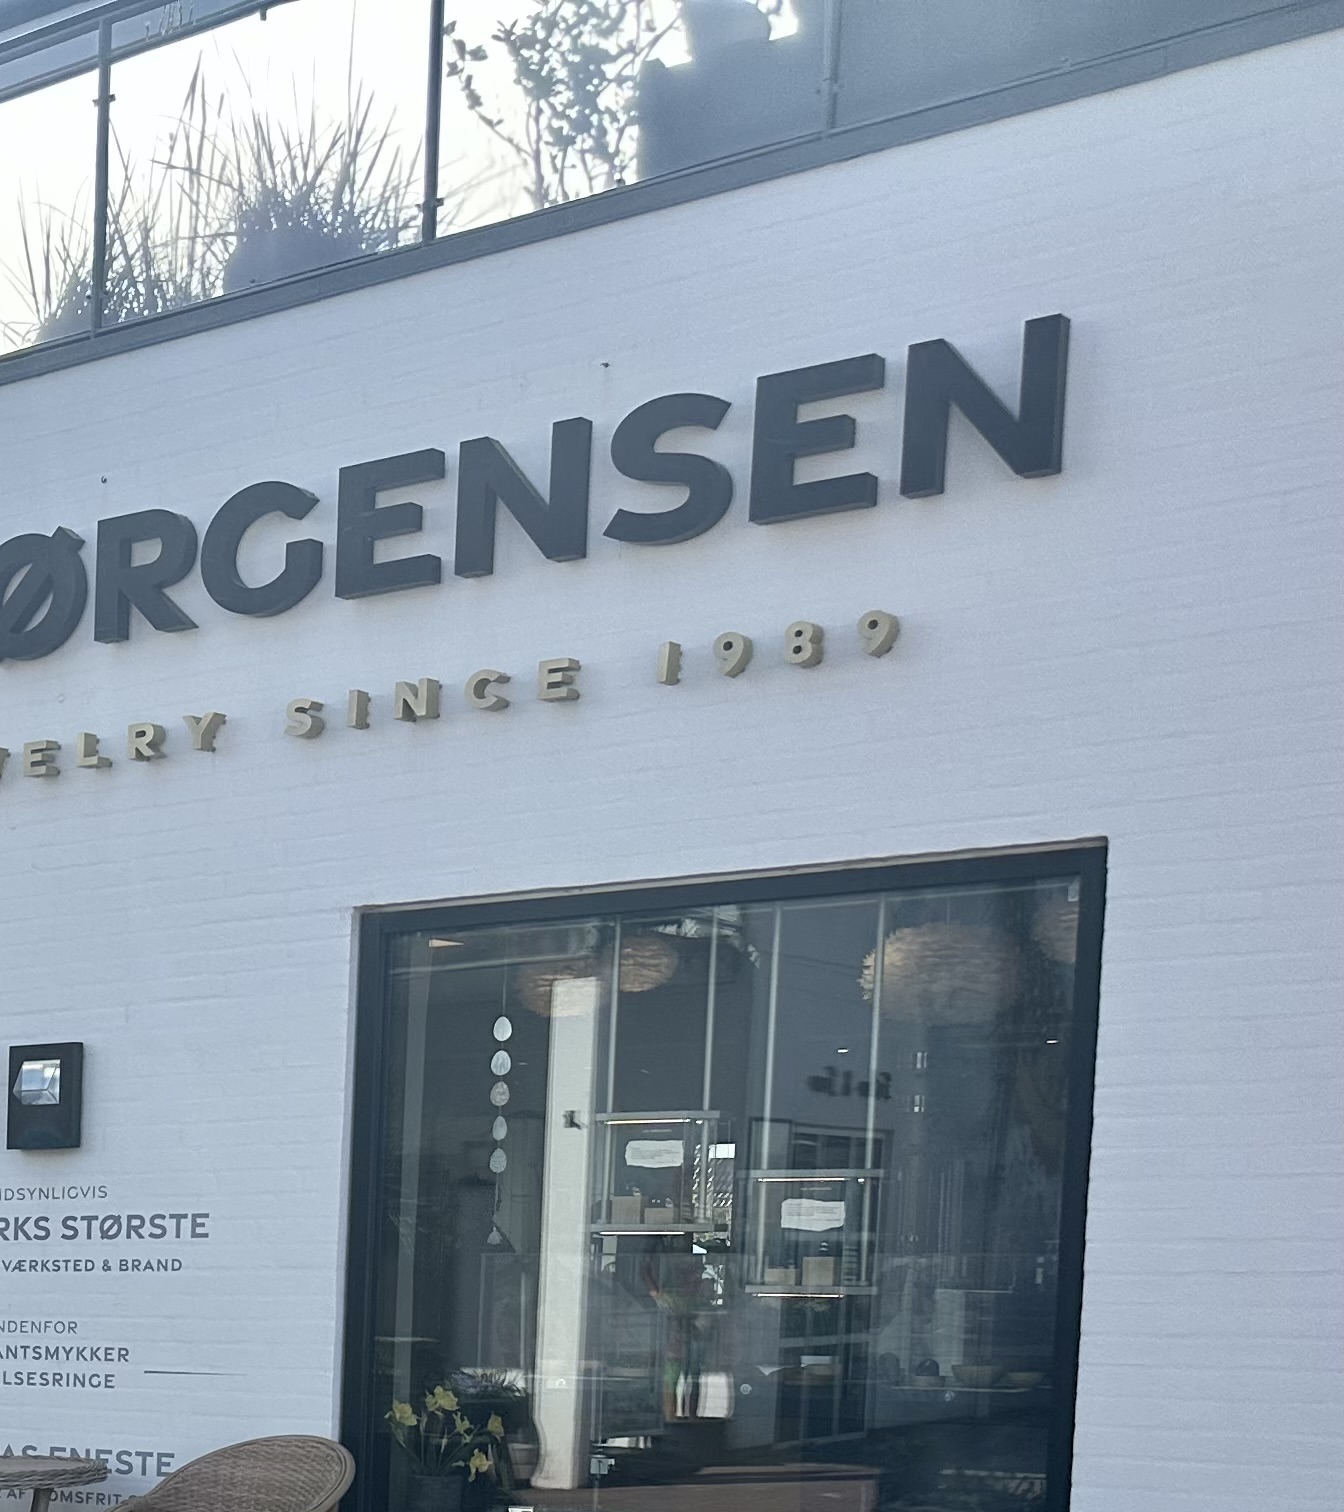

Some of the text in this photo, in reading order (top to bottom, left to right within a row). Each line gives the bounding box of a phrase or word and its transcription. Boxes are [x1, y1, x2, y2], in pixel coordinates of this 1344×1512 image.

[284, 657, 583, 739] SINCE
[658, 609, 901, 686] 1989
[61, 1212, 210, 1241] STØRSTE
[102, 1258, 112, 1273] &
[118, 1257, 183, 1273] BRAND
